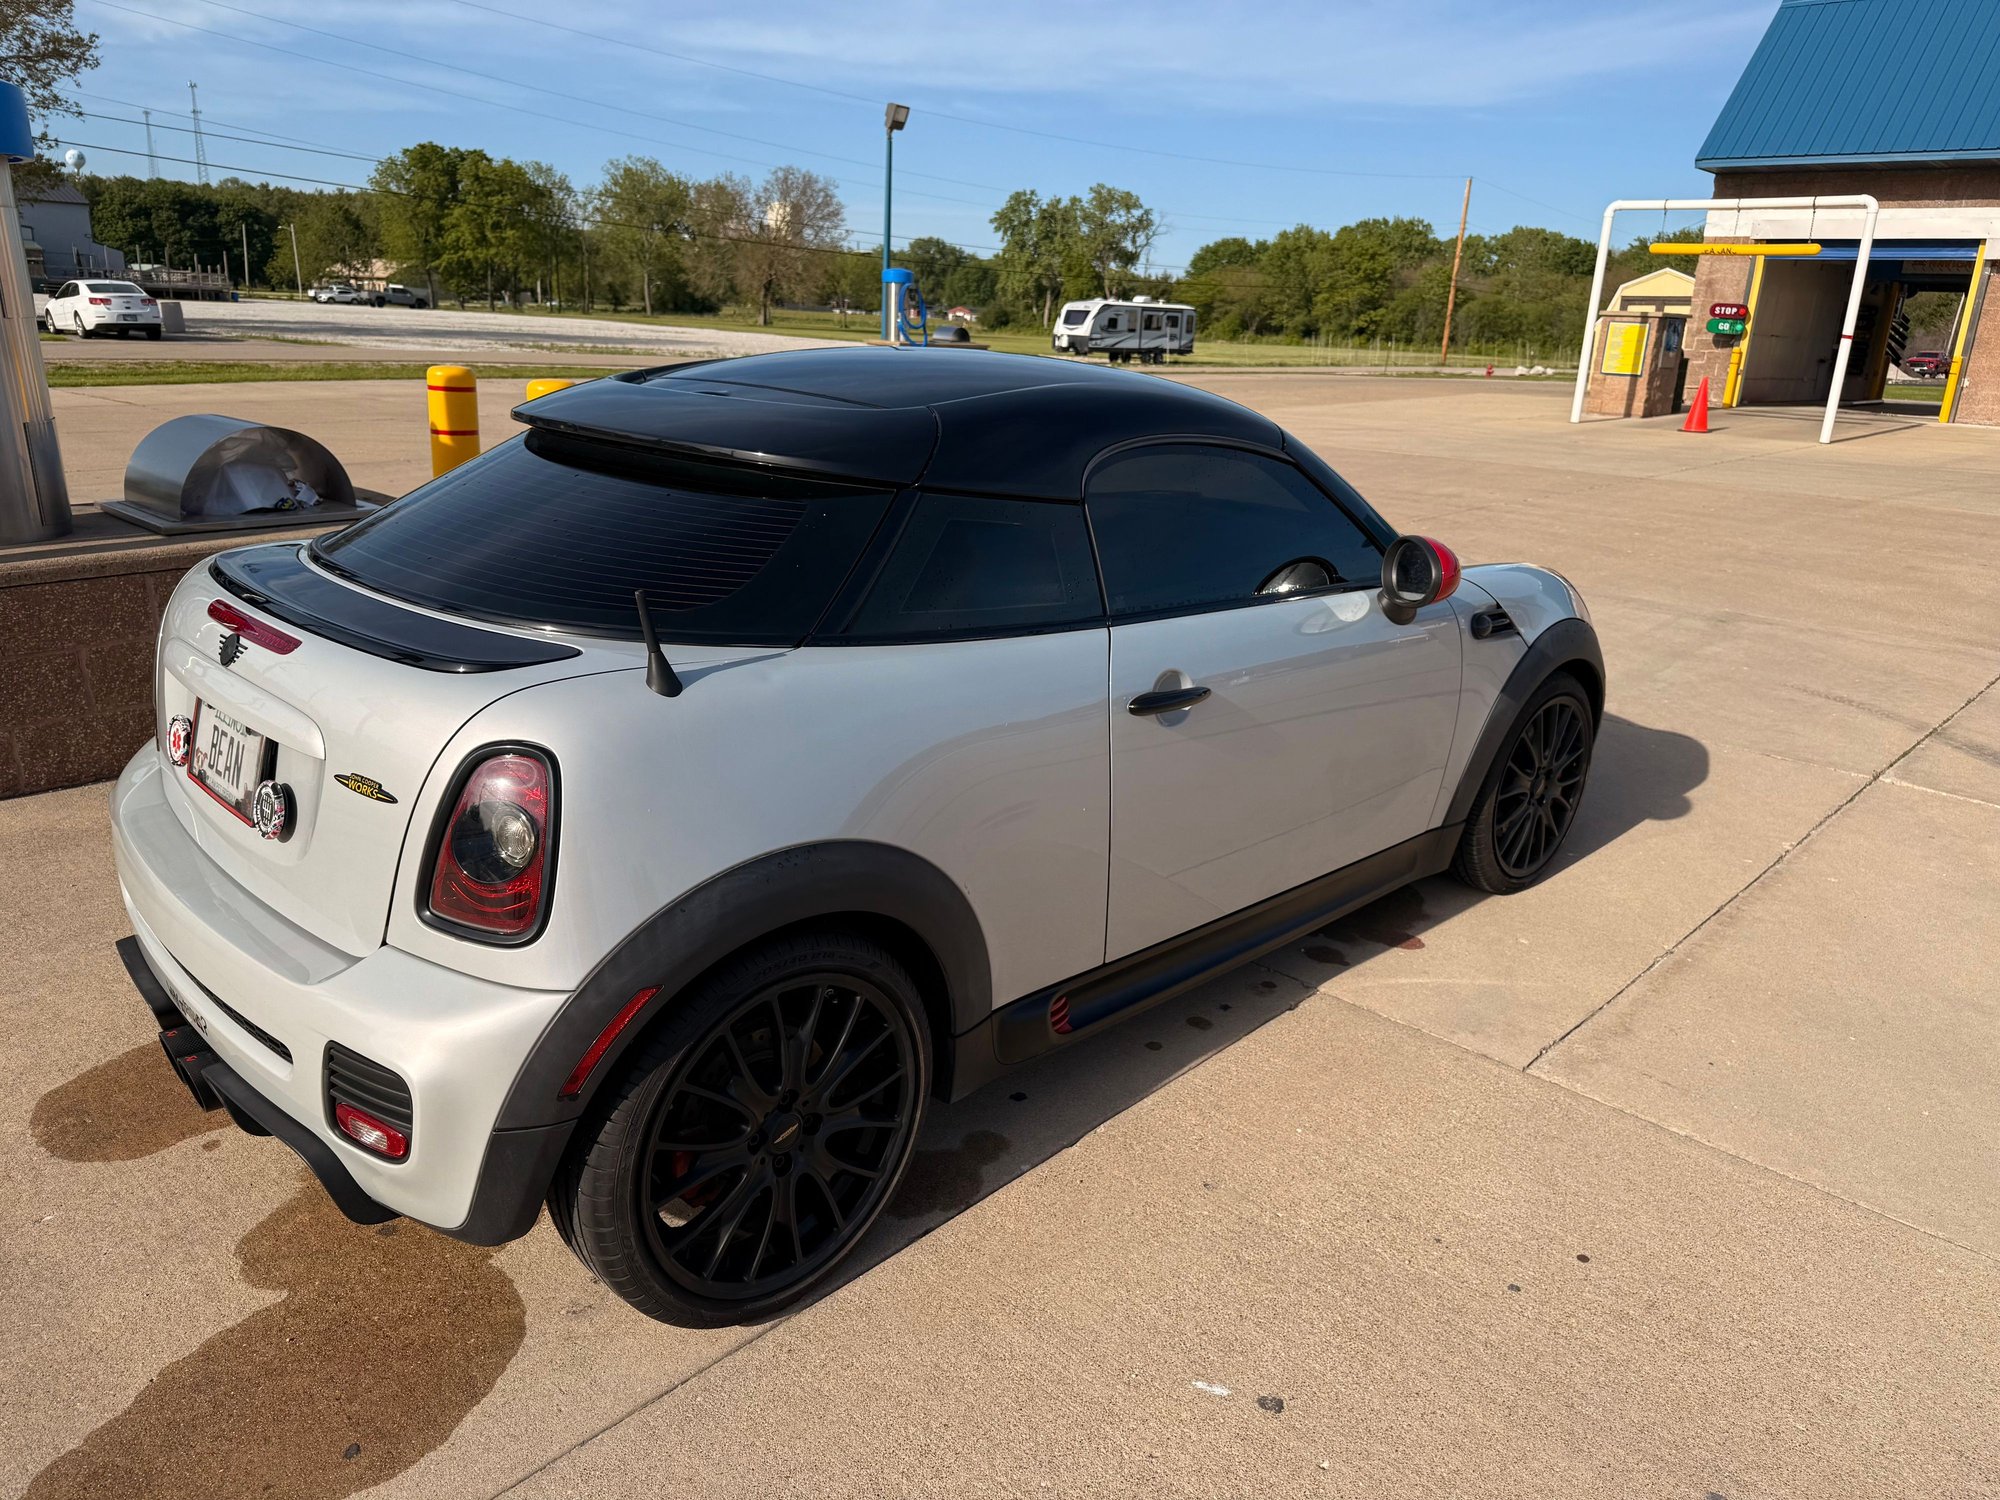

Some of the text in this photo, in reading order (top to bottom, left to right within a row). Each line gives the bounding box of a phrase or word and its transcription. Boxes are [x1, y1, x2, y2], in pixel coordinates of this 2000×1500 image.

[1714, 306, 1738, 315] STOP
[1718, 322, 1730, 331] GO
[215, 709, 247, 737] ILLINOI
[207, 724, 245, 790] BEAN
[348, 778, 379, 799] WORKS
